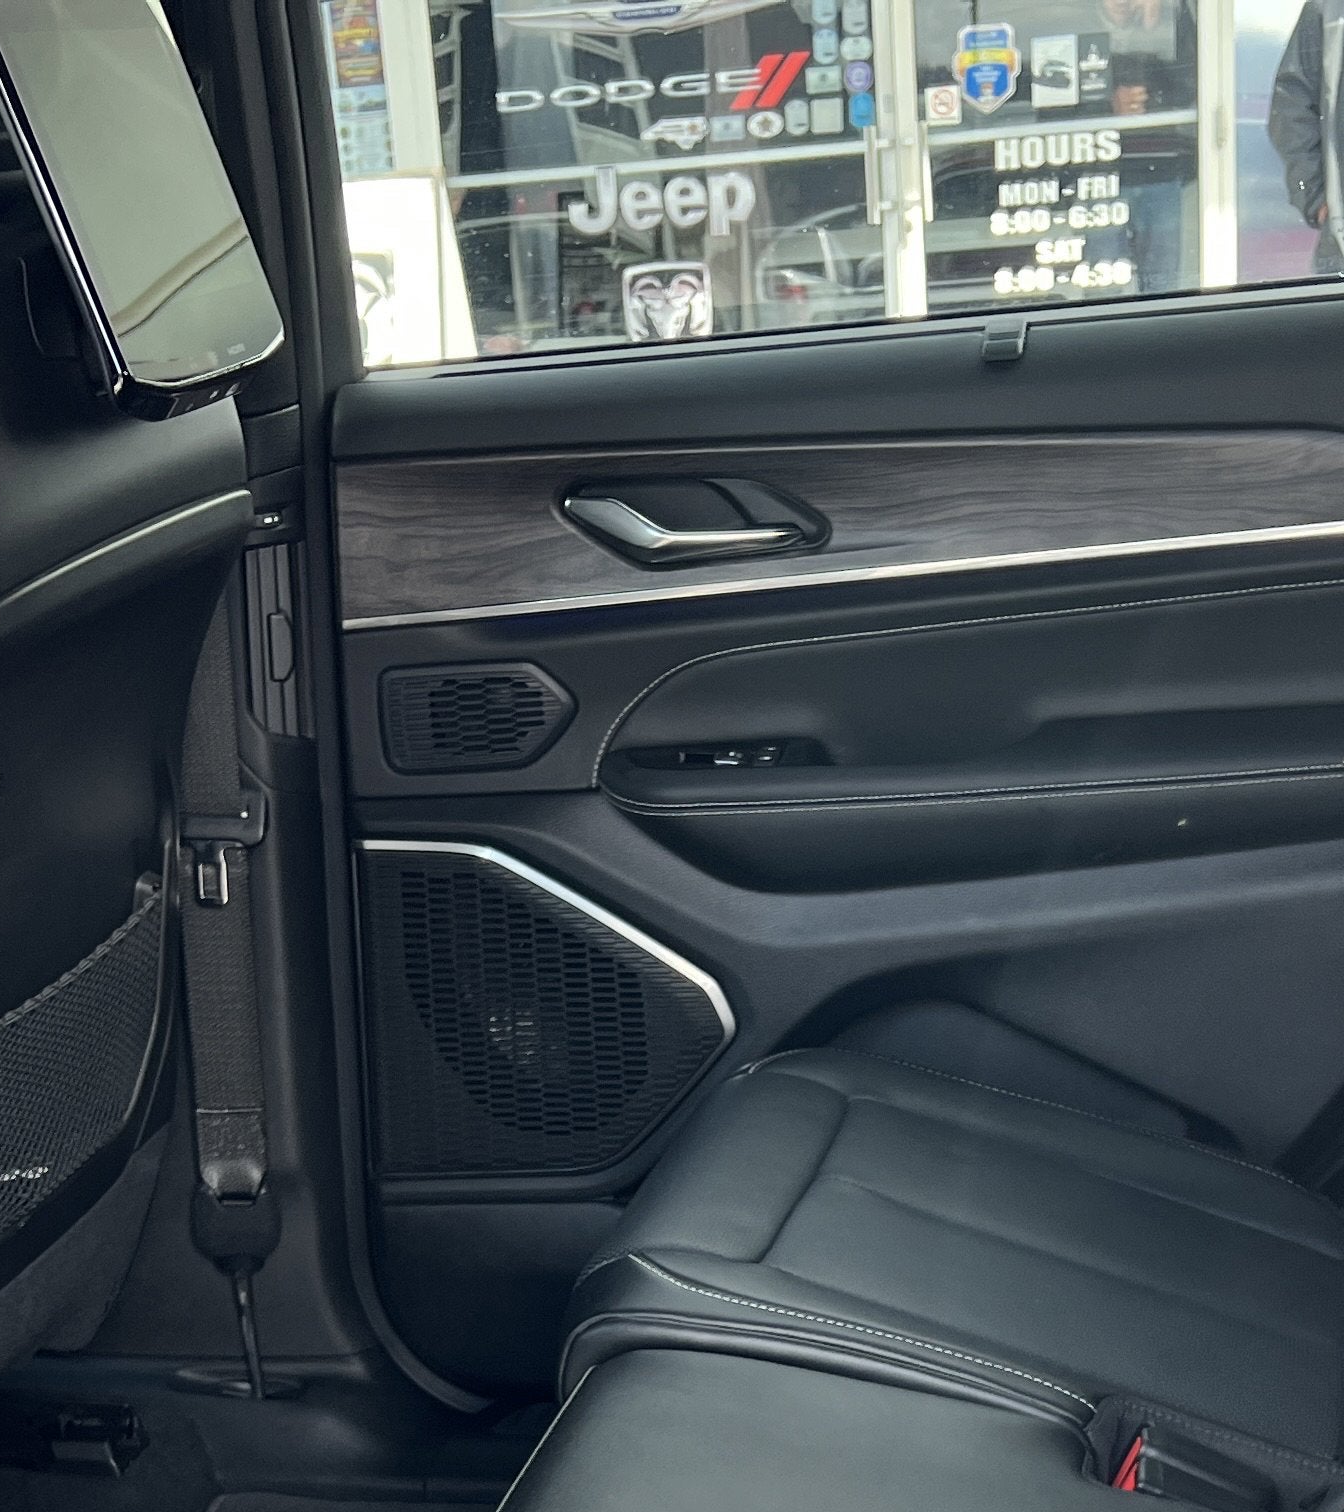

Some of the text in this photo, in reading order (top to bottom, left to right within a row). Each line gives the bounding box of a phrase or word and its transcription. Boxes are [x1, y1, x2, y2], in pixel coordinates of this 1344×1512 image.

[496, 69, 762, 112] DODGE
[994, 129, 1122, 171] HOURS
[568, 167, 755, 235] Jeep
[1036, 237, 1086, 264] SAT
